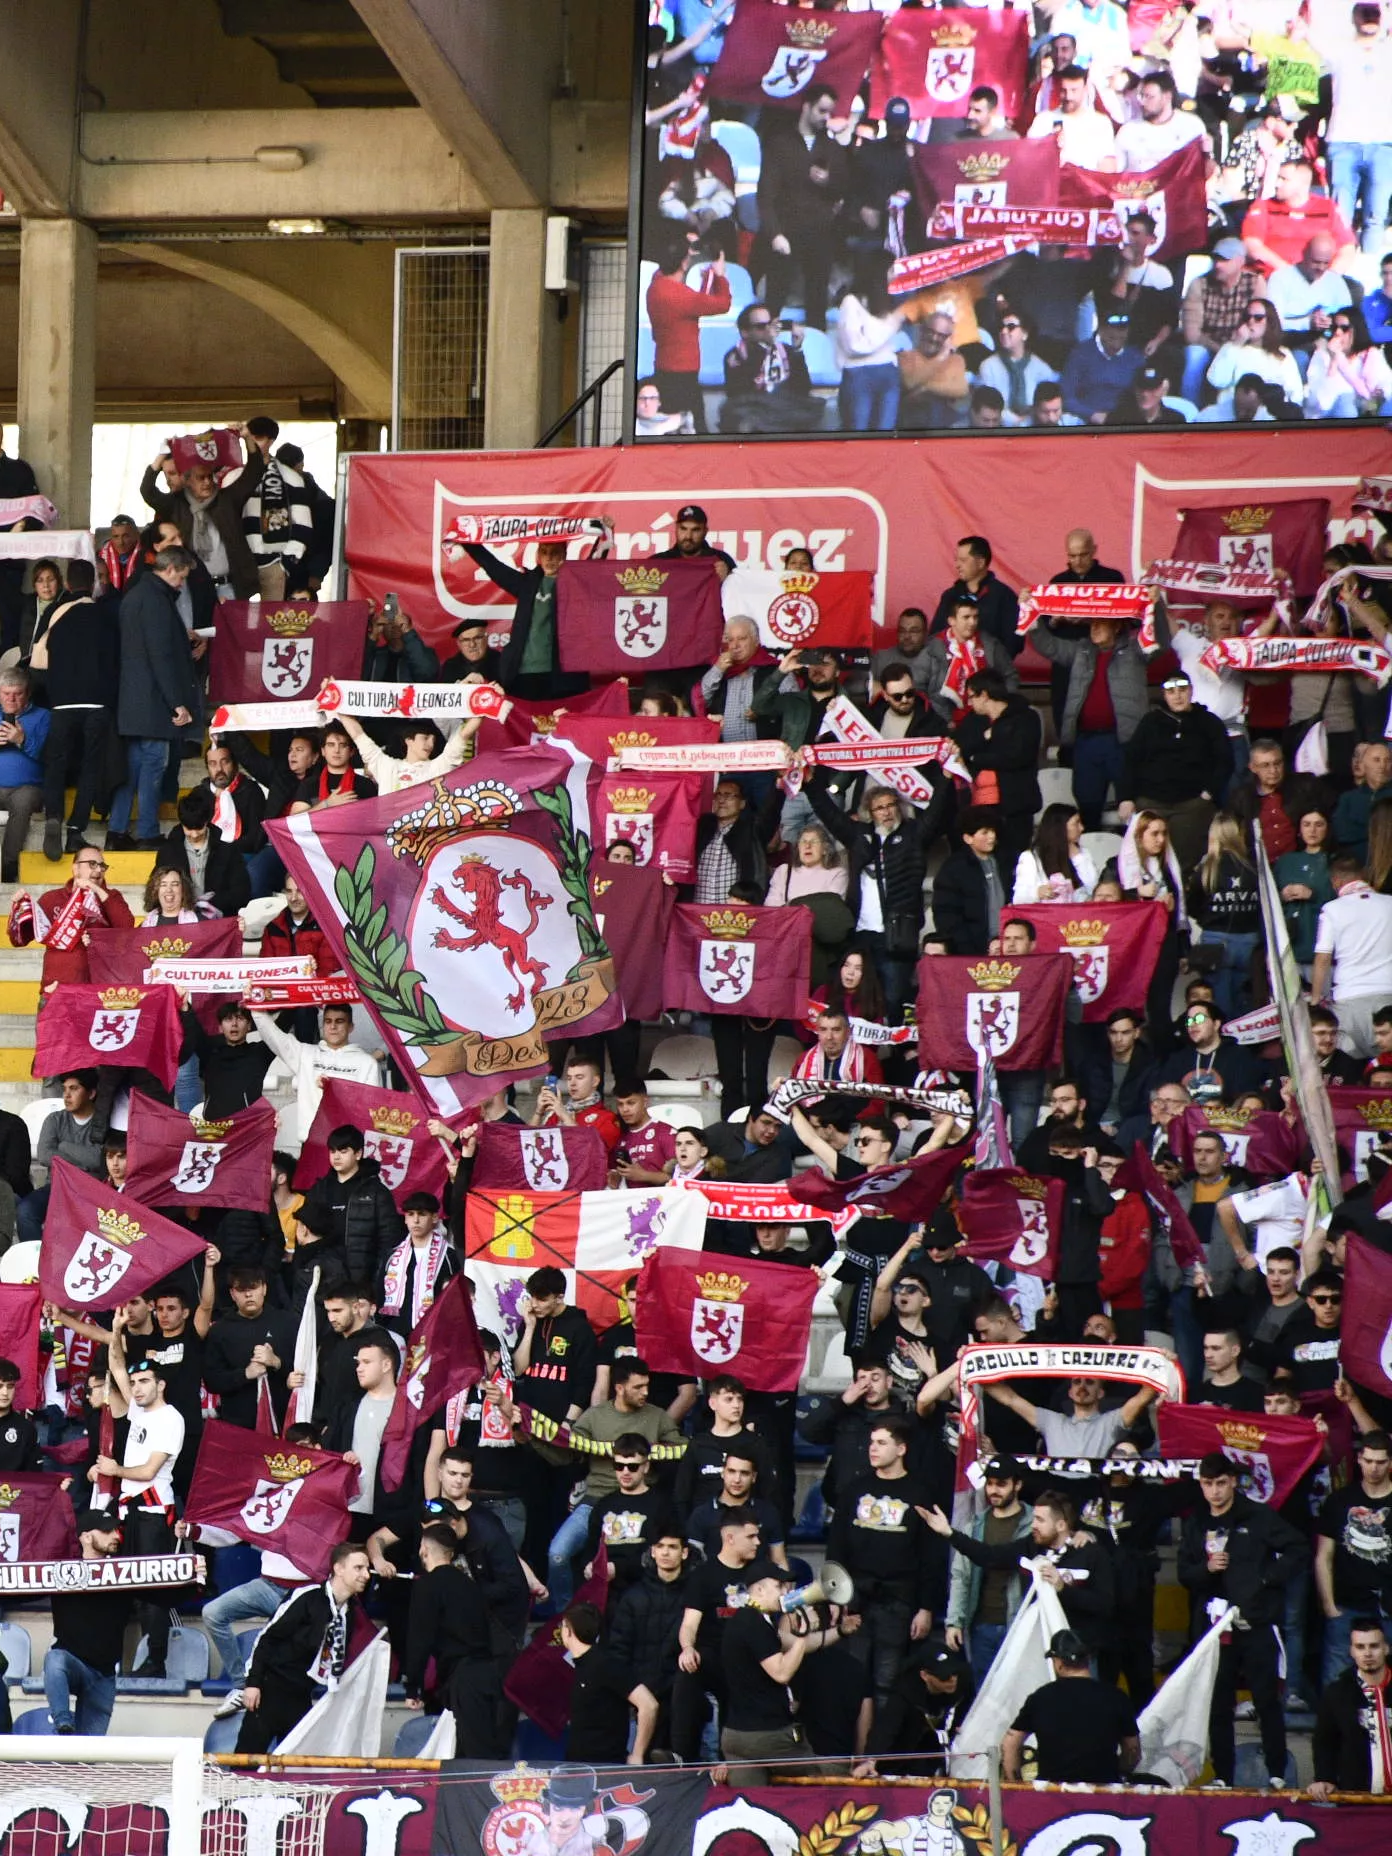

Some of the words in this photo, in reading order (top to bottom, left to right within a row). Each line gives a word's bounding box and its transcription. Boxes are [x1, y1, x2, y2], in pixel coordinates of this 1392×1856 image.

[348, 689, 399, 709] CULTURAL
[416, 691, 463, 710] LEONESA
[164, 970, 233, 981] CULTURAL
[238, 965, 299, 980] LEONESA
[297, 984, 338, 993] CULTURAL
[965, 1351, 1039, 1374] ORGULLO
[1062, 1351, 1140, 1369] CAZURRO
[87, 1556, 193, 1587] CAZURRO
